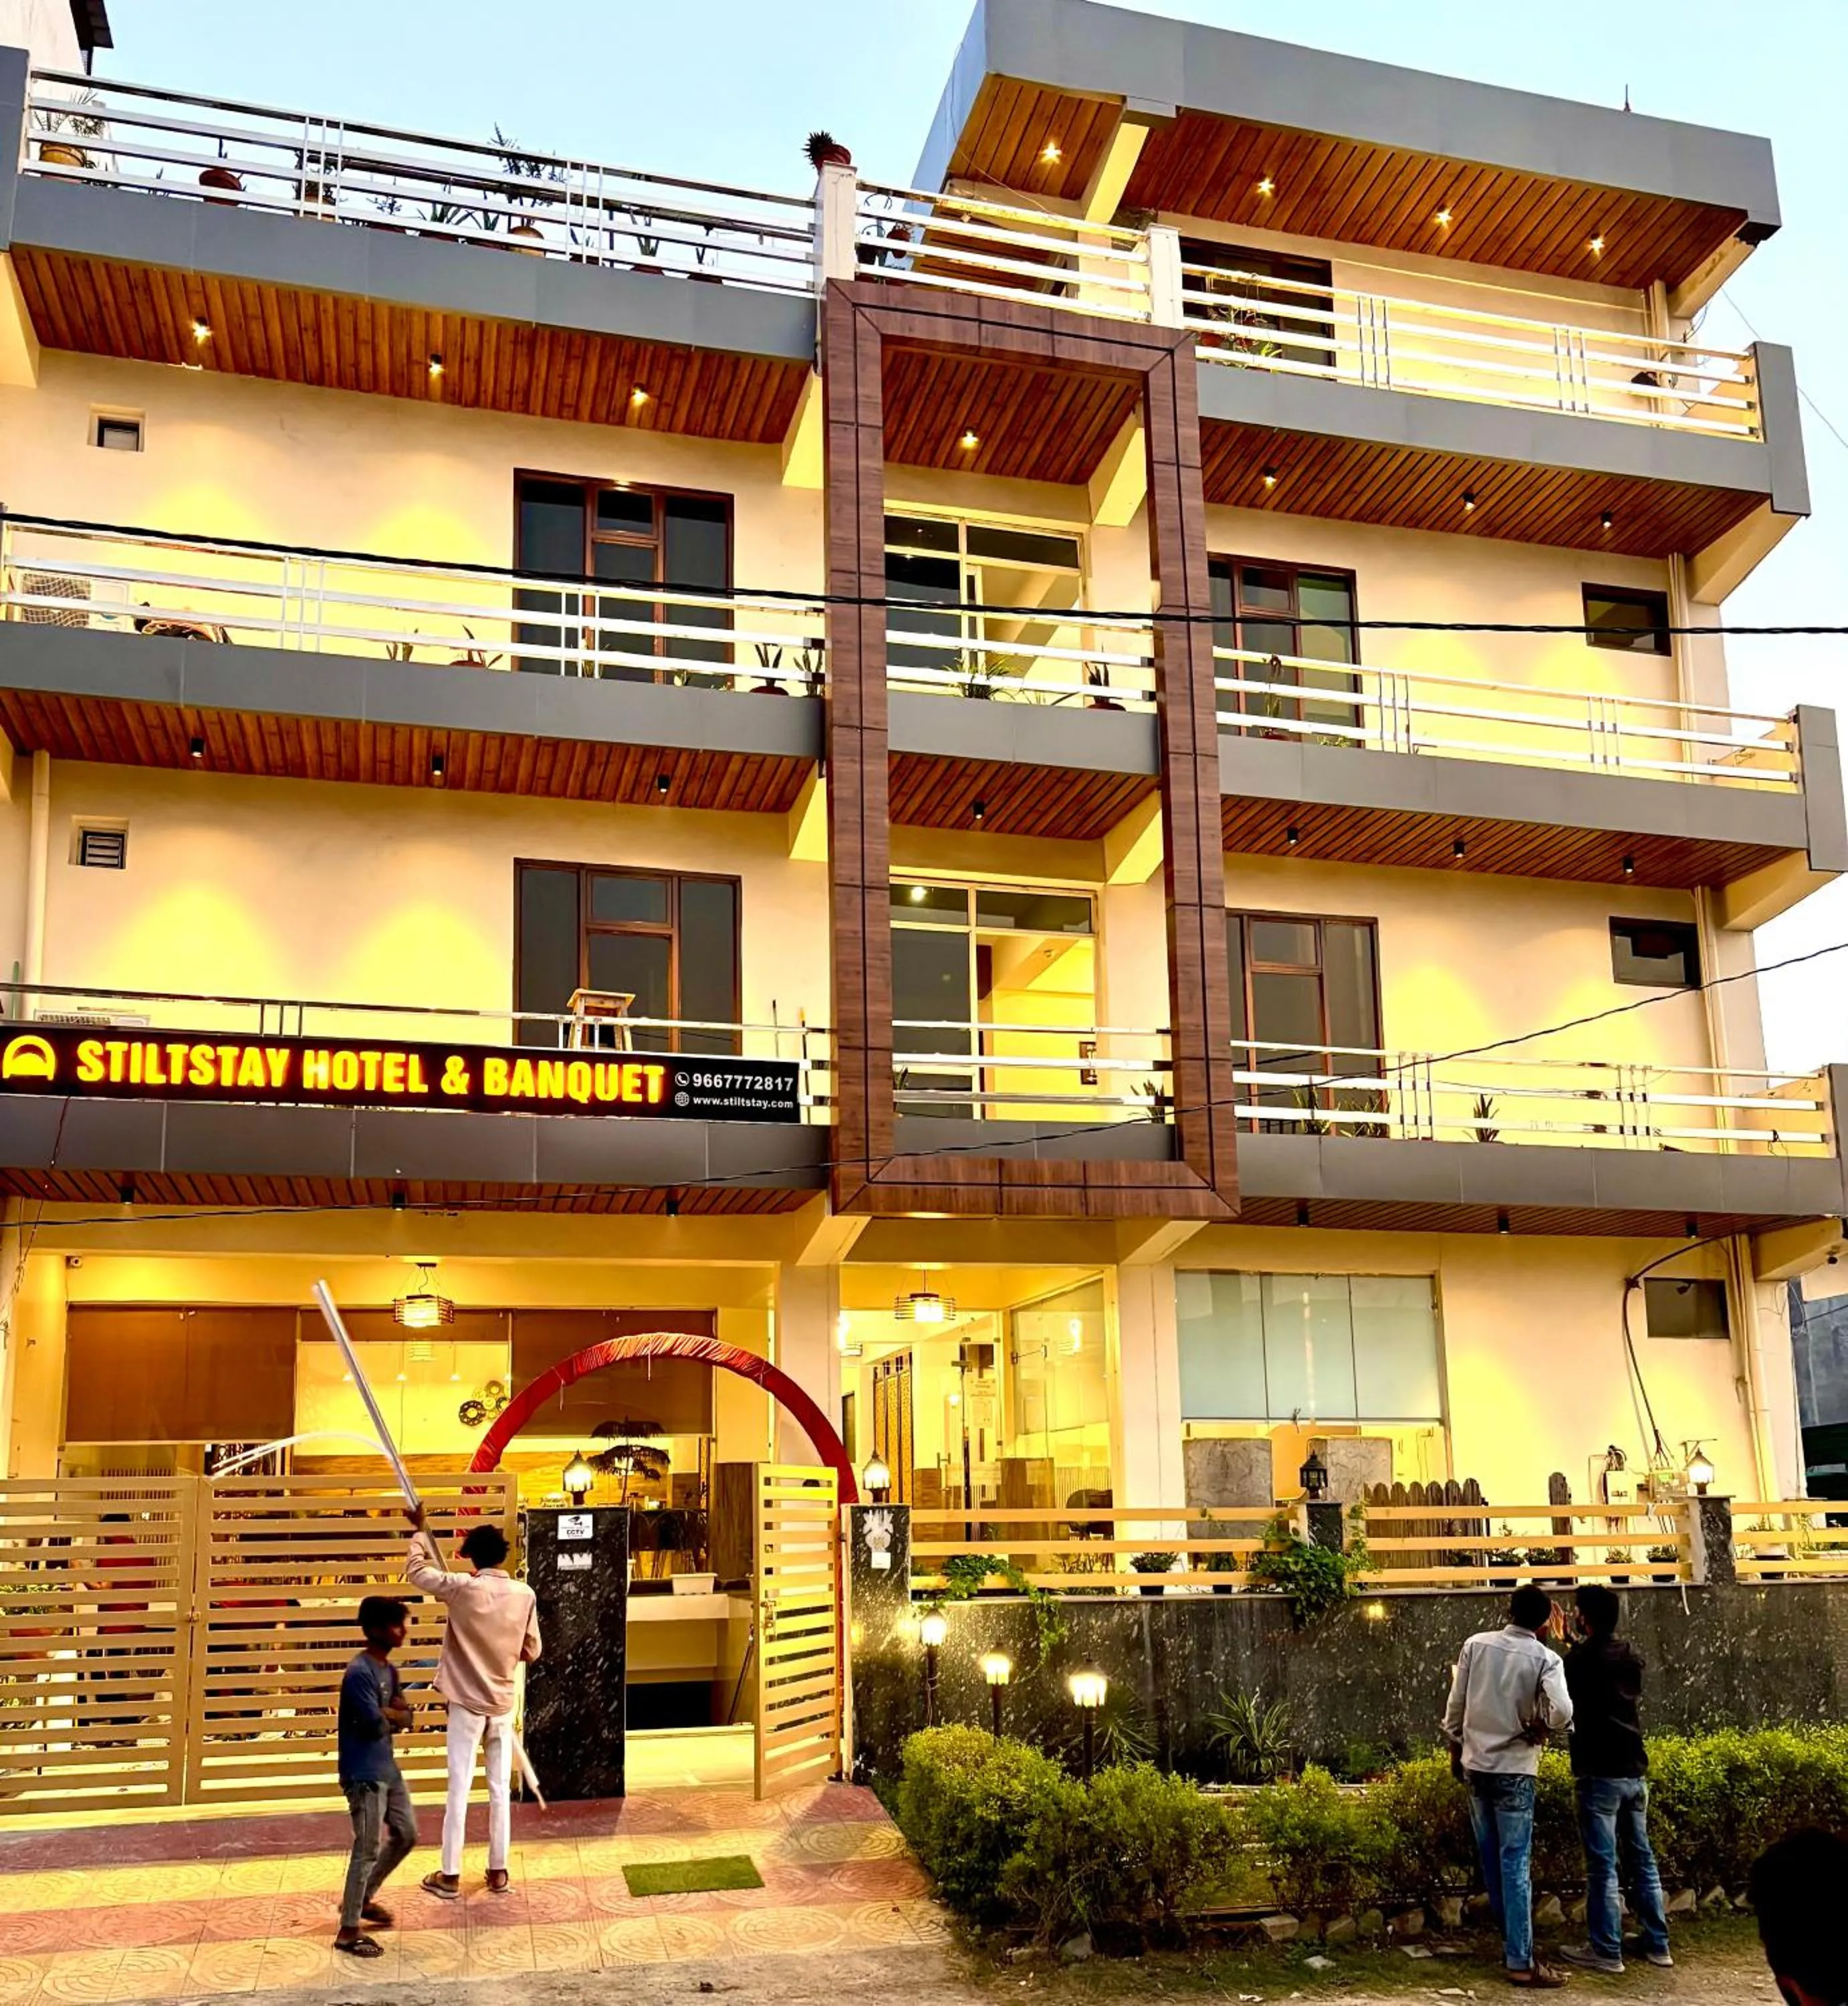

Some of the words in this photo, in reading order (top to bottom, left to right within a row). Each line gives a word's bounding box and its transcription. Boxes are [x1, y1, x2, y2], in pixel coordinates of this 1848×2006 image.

[77, 1040, 290, 1087] STILTSTAY
[303, 1050, 429, 1093] HOTEL
[441, 1056, 469, 1095] &
[484, 1058, 664, 1103] BANQUET
[692, 1073, 794, 1091] 9667772817
[693, 1097, 794, 1109] www.stiltstay.com
